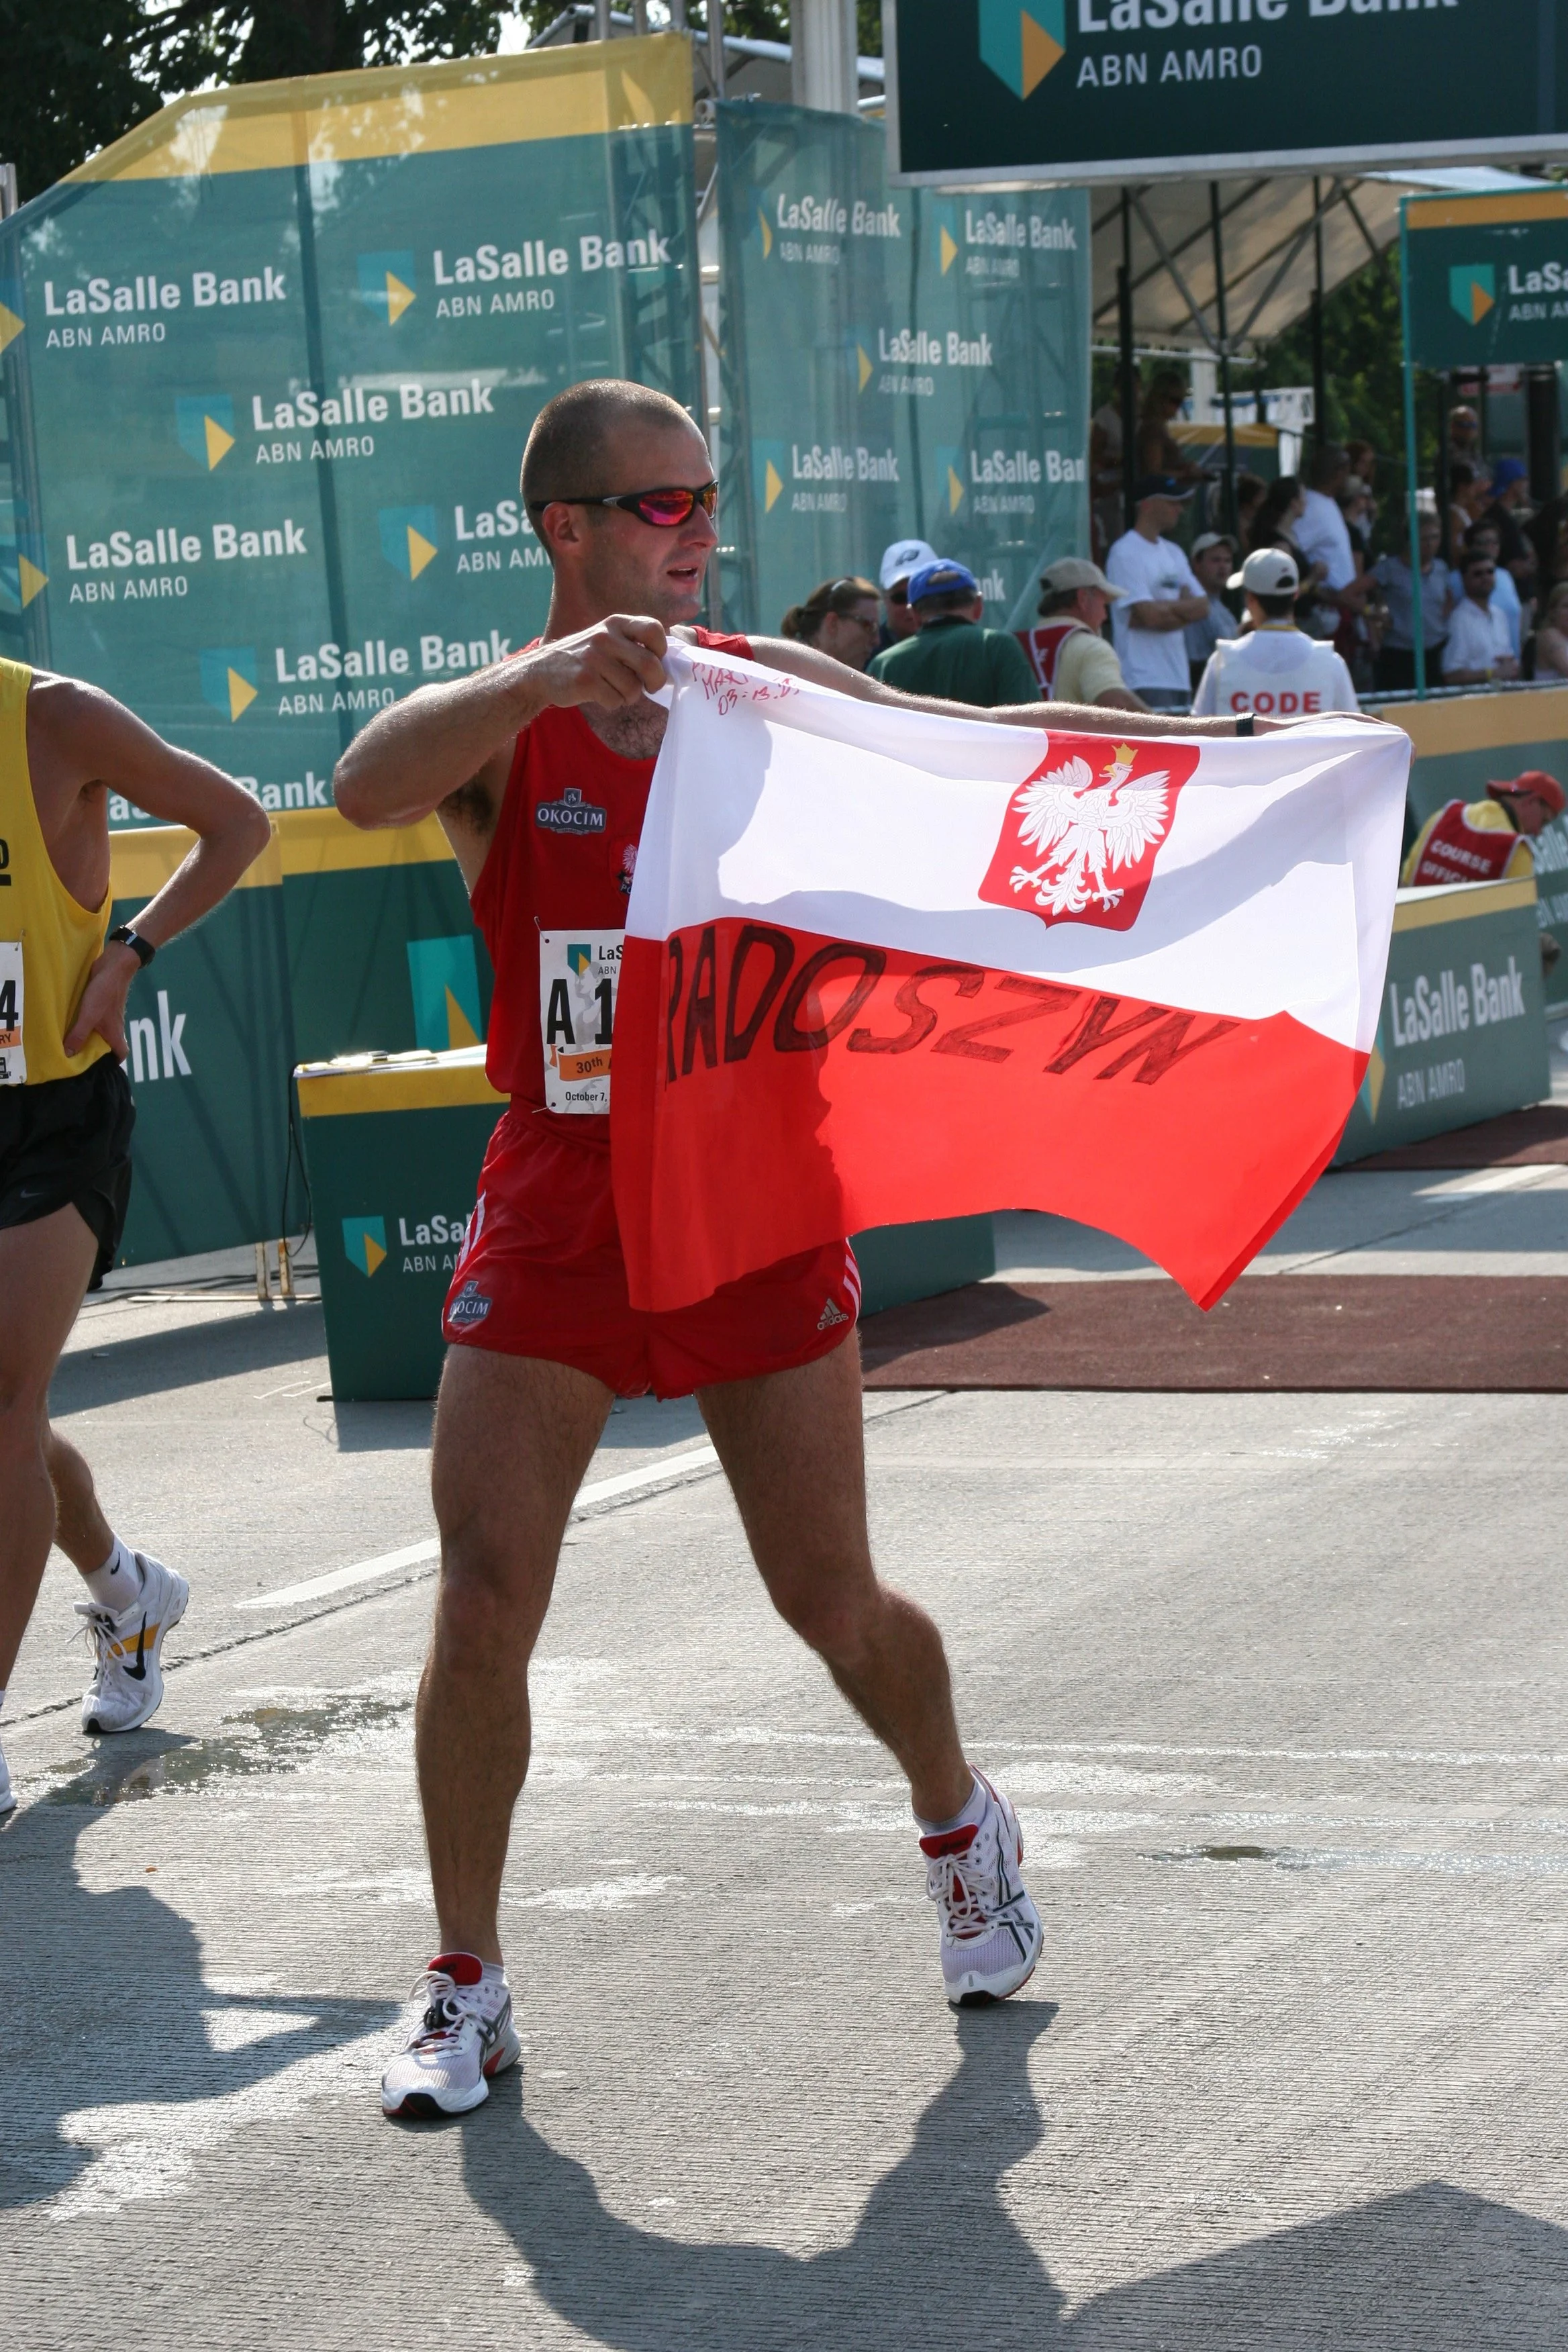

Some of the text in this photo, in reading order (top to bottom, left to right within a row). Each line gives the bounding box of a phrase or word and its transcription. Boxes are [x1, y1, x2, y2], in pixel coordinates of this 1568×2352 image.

[1076, 44, 1262, 89] ABN AMRO
[777, 193, 901, 238] LaSalle Bank
[966, 209, 1077, 250] LaSalle Bank
[434, 228, 671, 285] LaSalle Bank
[44, 266, 287, 315] LaSalle Bank
[436, 289, 555, 319] ABN AMRO
[46, 323, 166, 348] ABN AMRO
[879, 328, 993, 367] LaSalle Bank
[253, 379, 495, 432] LaSalle Bank
[256, 436, 375, 464] ABN AMRO
[793, 444, 899, 483] LaSalle Bank
[971, 449, 1040, 483] LaSalle
[67, 520, 307, 571] LaSalle Bank
[456, 550, 501, 574] ABN
[69, 576, 188, 603] ABN AMRO
[275, 630, 511, 683] LaSalle Bank
[279, 687, 395, 715] ABN AMRO
[1230, 691, 1322, 714] CODE
[538, 807, 603, 827] OKOCIM
[1427, 838, 1492, 875] COURSE
[598, 966, 616, 975] ABN
[666, 924, 1241, 1086] RADOSZYN
[1389, 954, 1526, 1048] LaSalle Bank
[119, 990, 192, 1083] nk
[577, 1057, 603, 1074] 30th
[1397, 1058, 1465, 1110] ABN AMRO
[565, 1091, 607, 1103] October 7,
[403, 1255, 436, 1273] ABN
